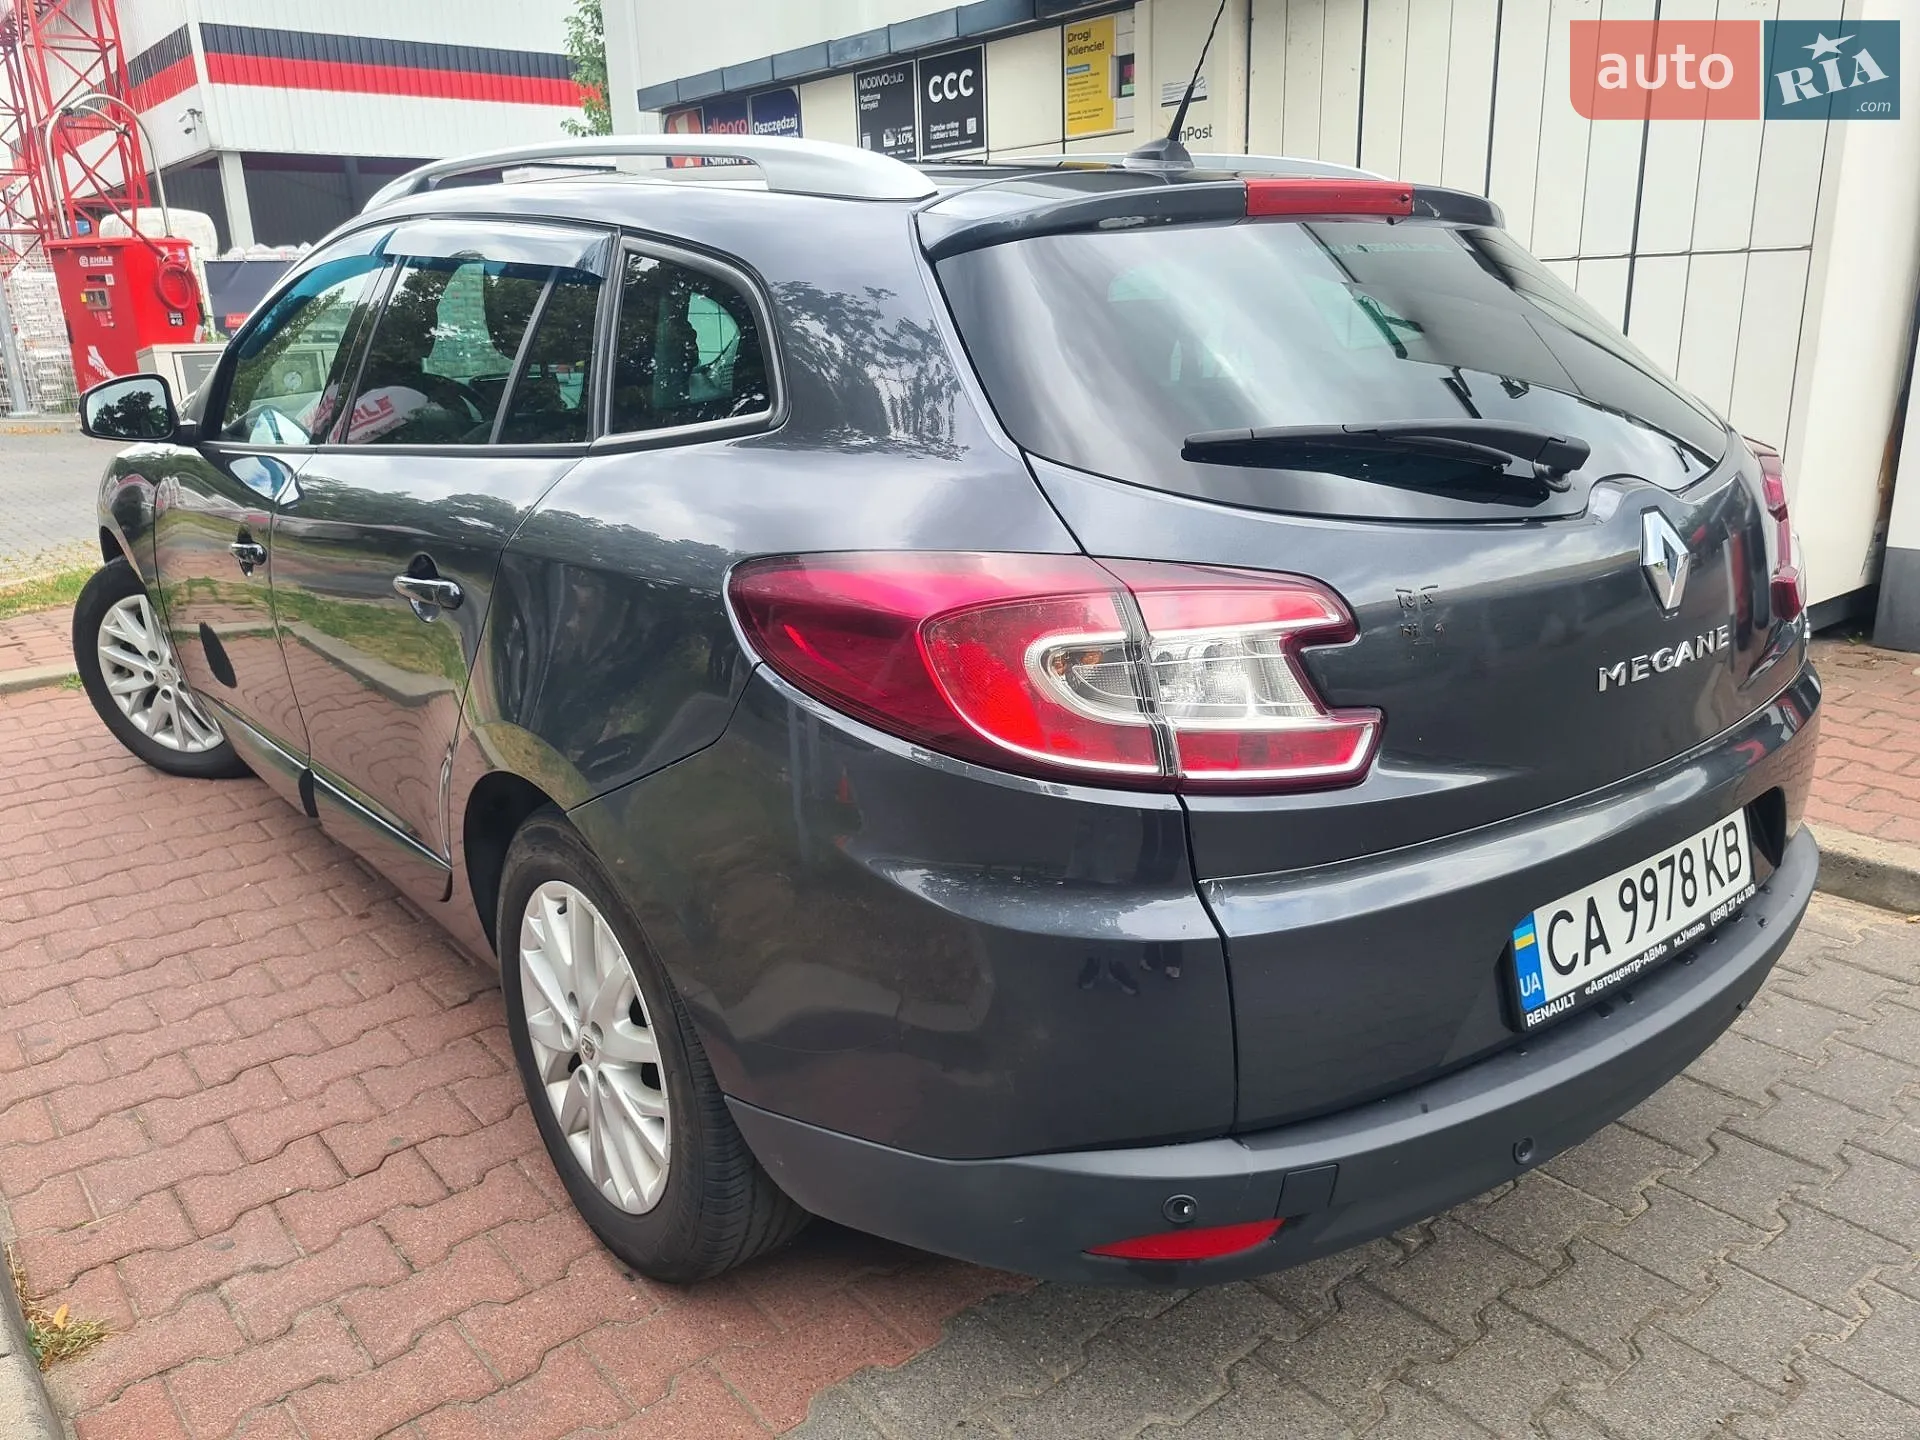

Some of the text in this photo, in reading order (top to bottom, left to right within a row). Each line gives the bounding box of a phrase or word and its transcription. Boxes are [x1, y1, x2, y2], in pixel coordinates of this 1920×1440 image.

[1067, 41, 1105, 56] Kliencie!
[1068, 28, 1091, 43] Drogi
[928, 68, 974, 103] CCC
[897, 132, 914, 145] 10%
[1180, 123, 1213, 141] nPost
[1598, 625, 1730, 692] MEGANE
[1547, 821, 1742, 976] CA 9978 KB
[1519, 971, 1542, 997] UA
[1526, 991, 1576, 1027] RENAULT
